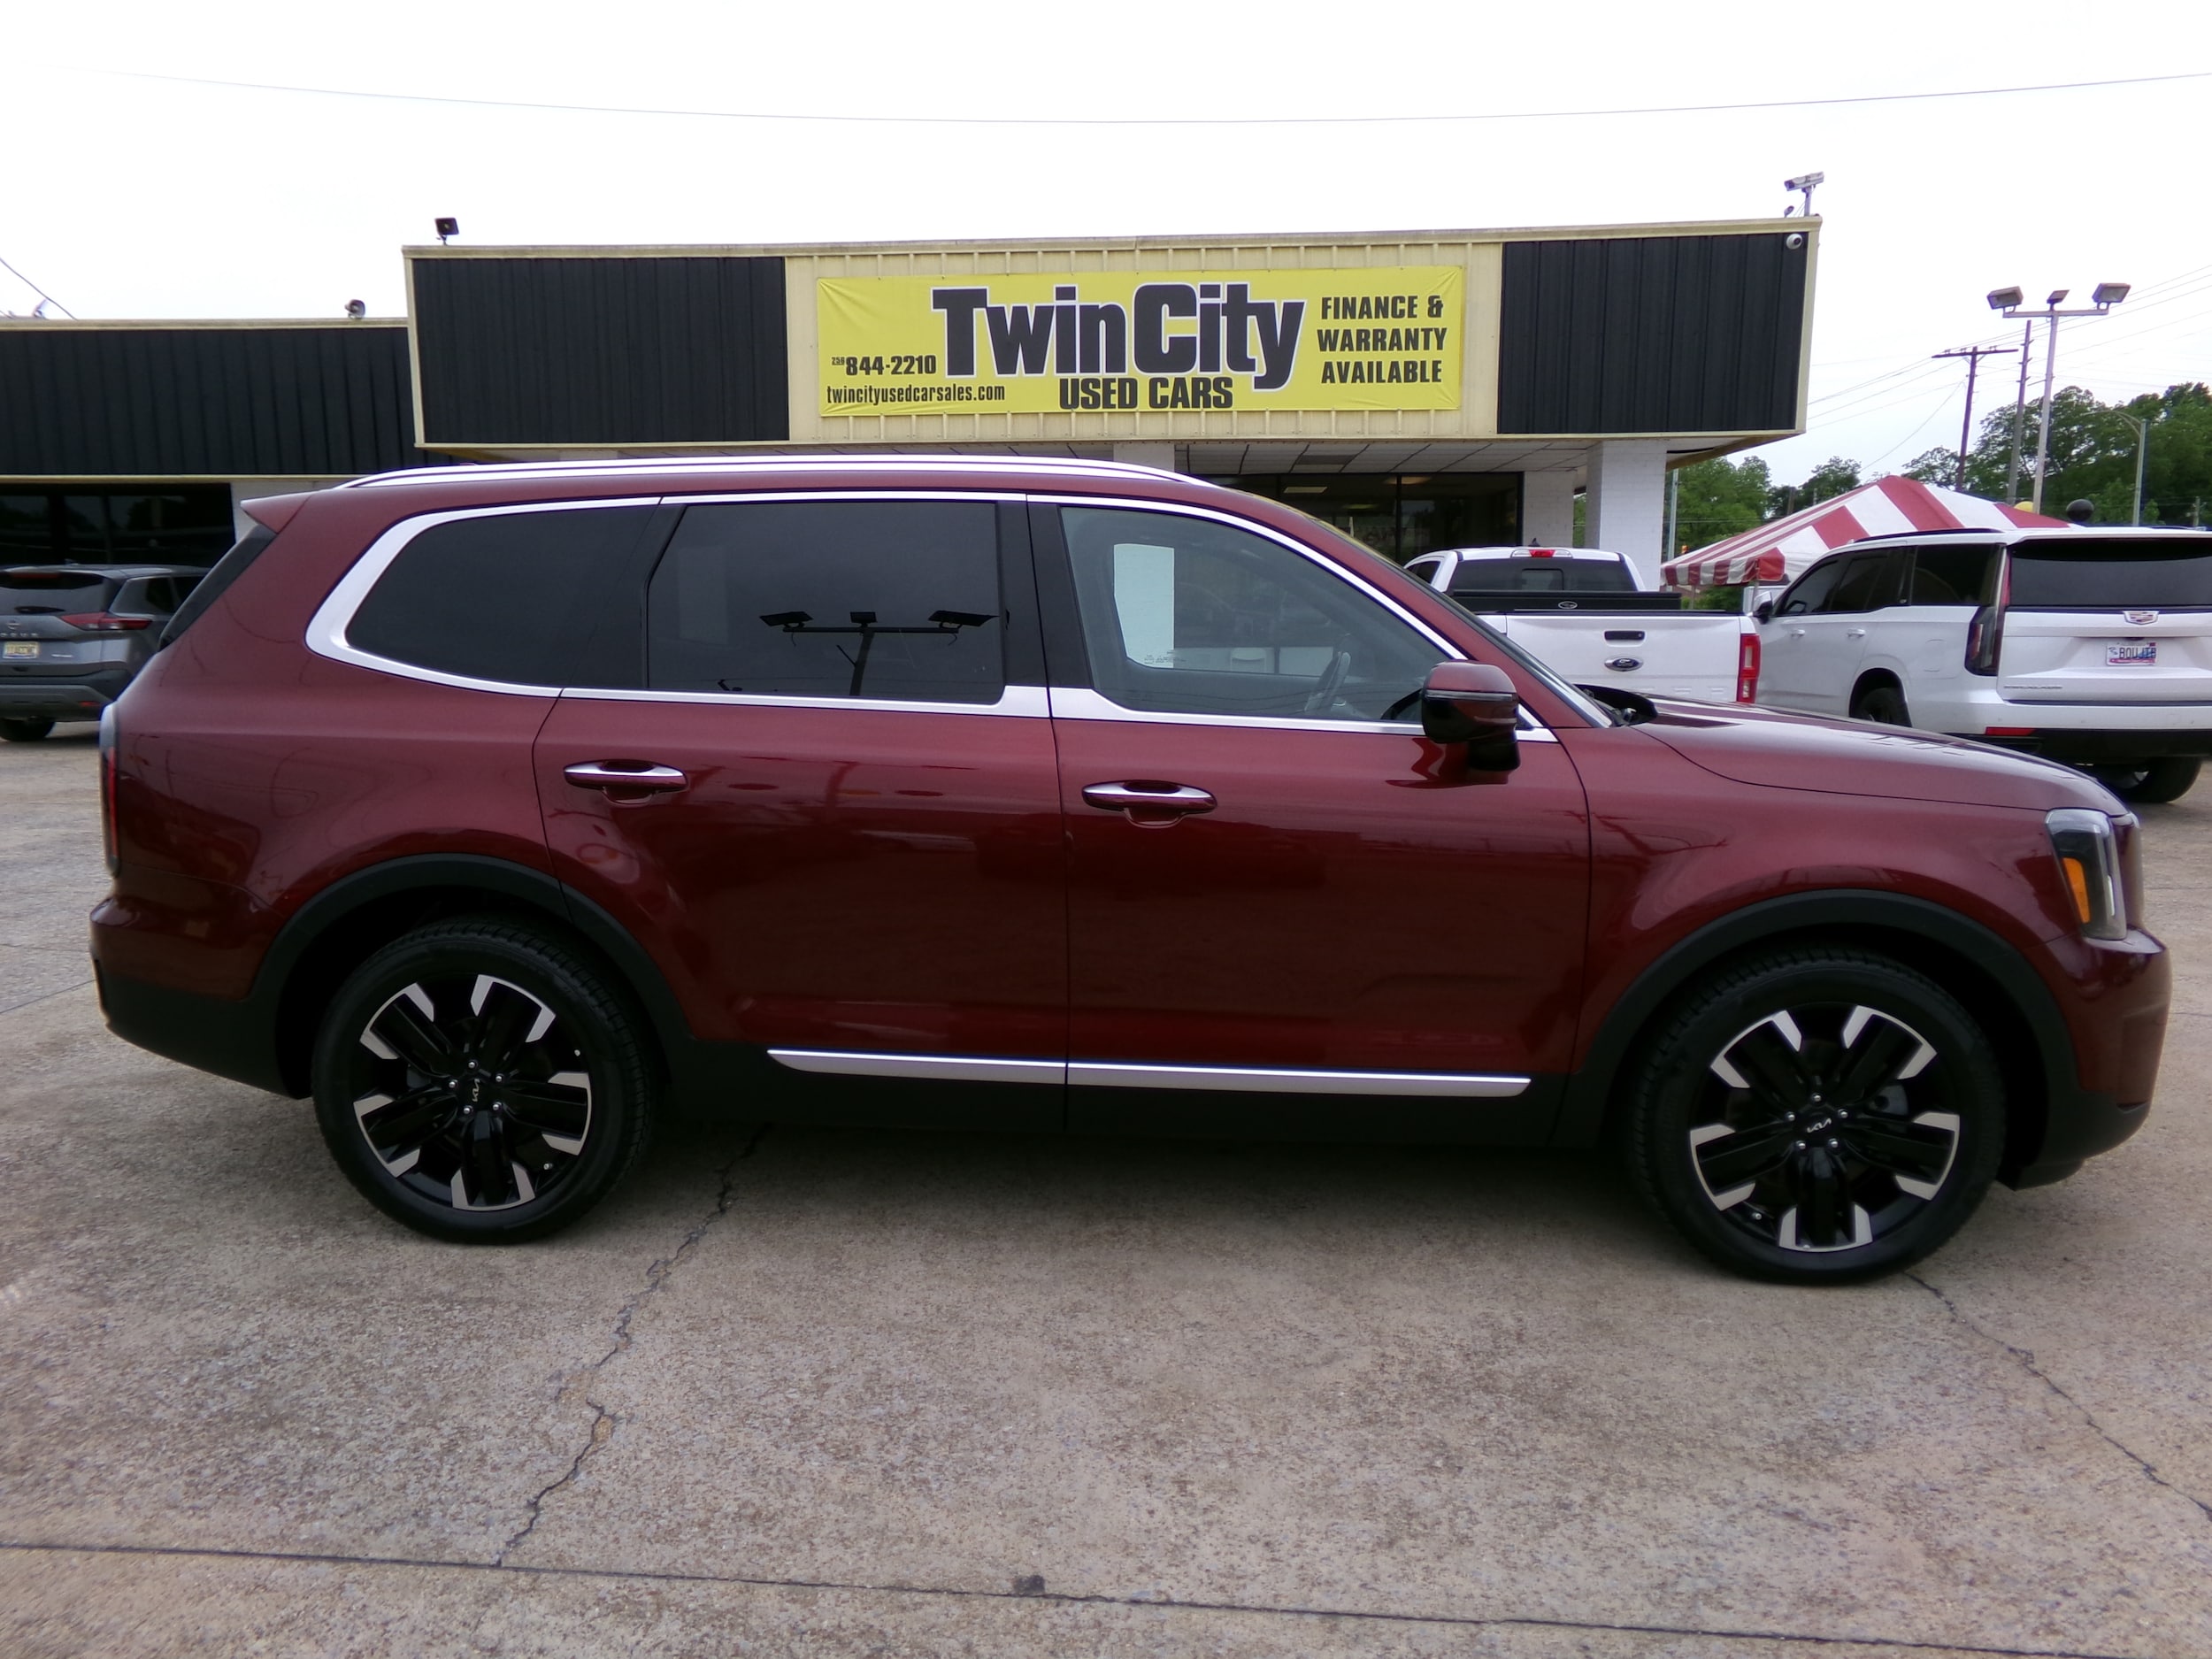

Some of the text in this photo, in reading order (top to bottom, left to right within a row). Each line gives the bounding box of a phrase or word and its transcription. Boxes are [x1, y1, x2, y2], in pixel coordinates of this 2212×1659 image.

[1321, 295, 1444, 319] FINANCE &
[1317, 327, 1448, 351] WARRANTY
[1321, 360, 1442, 383] AVAILABLE
[826, 384, 1005, 405] twincityusedcarsales.com
[1059, 377, 1233, 410] USED CARS
